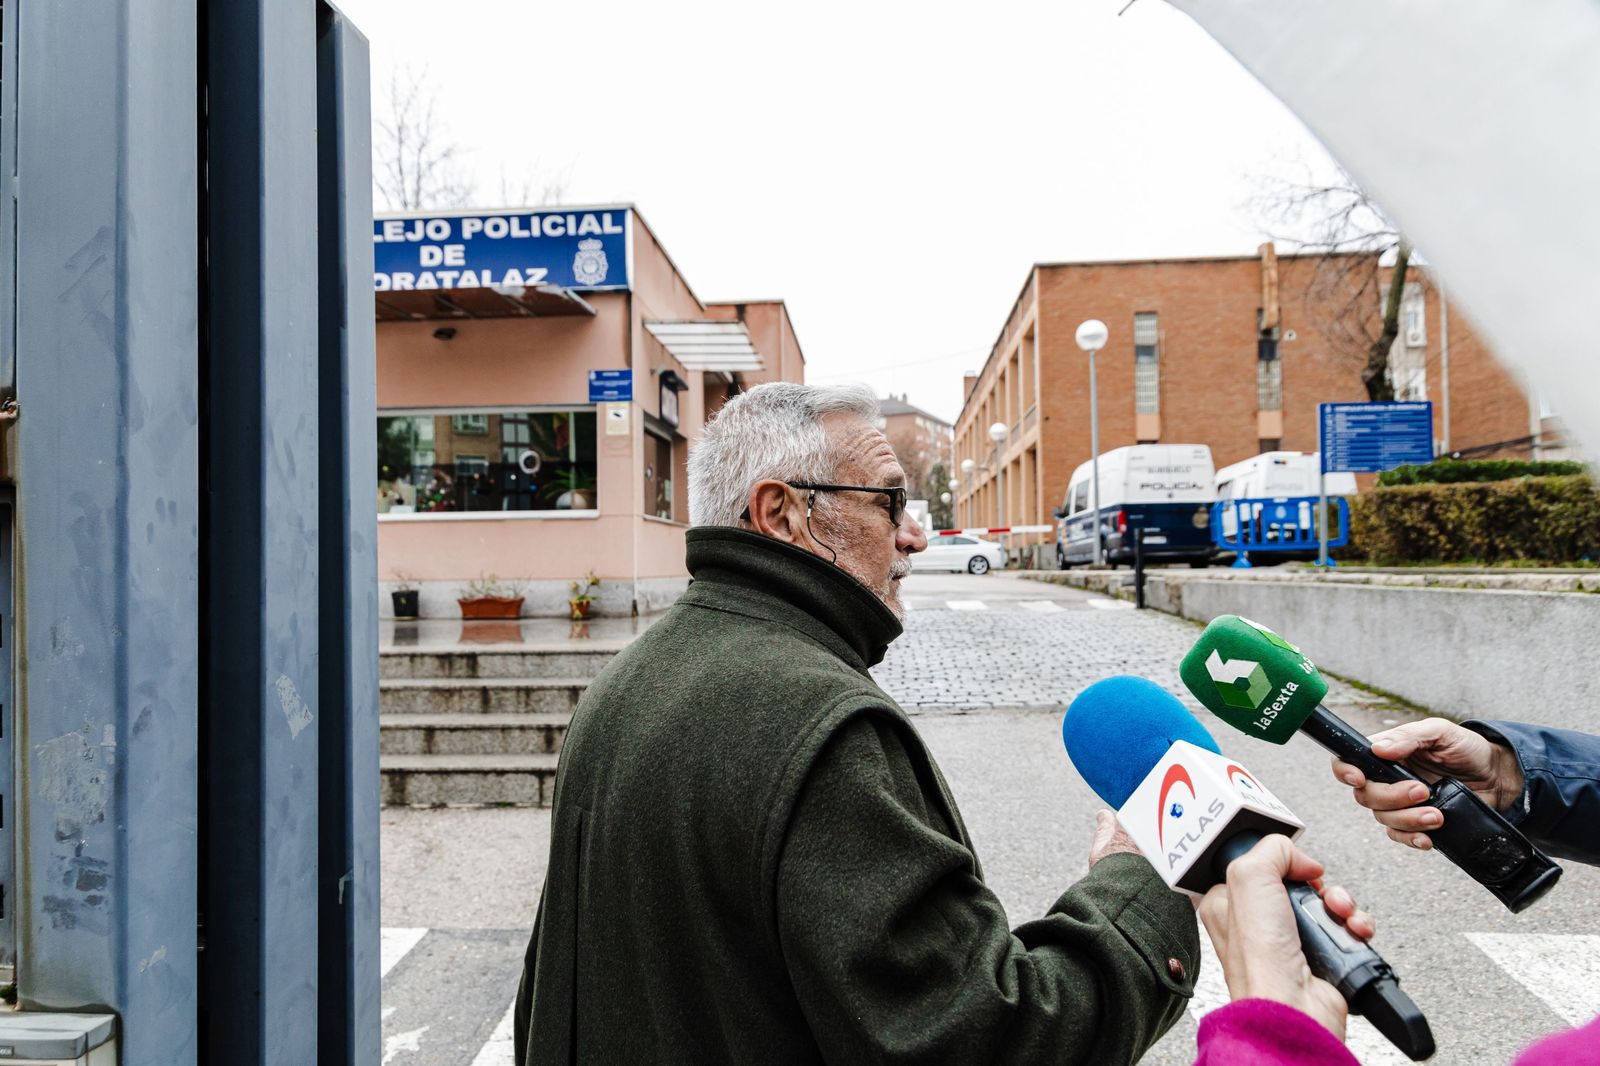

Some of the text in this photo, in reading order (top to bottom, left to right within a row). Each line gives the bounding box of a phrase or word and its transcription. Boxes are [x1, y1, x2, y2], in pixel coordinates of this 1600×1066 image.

[462, 213, 623, 240] POLICIAL
[420, 244, 465, 267] DE
[374, 267, 548, 291] ORATALAZ
[1253, 681, 1299, 731] laSexta
[1168, 798, 1225, 870] ATLAS
